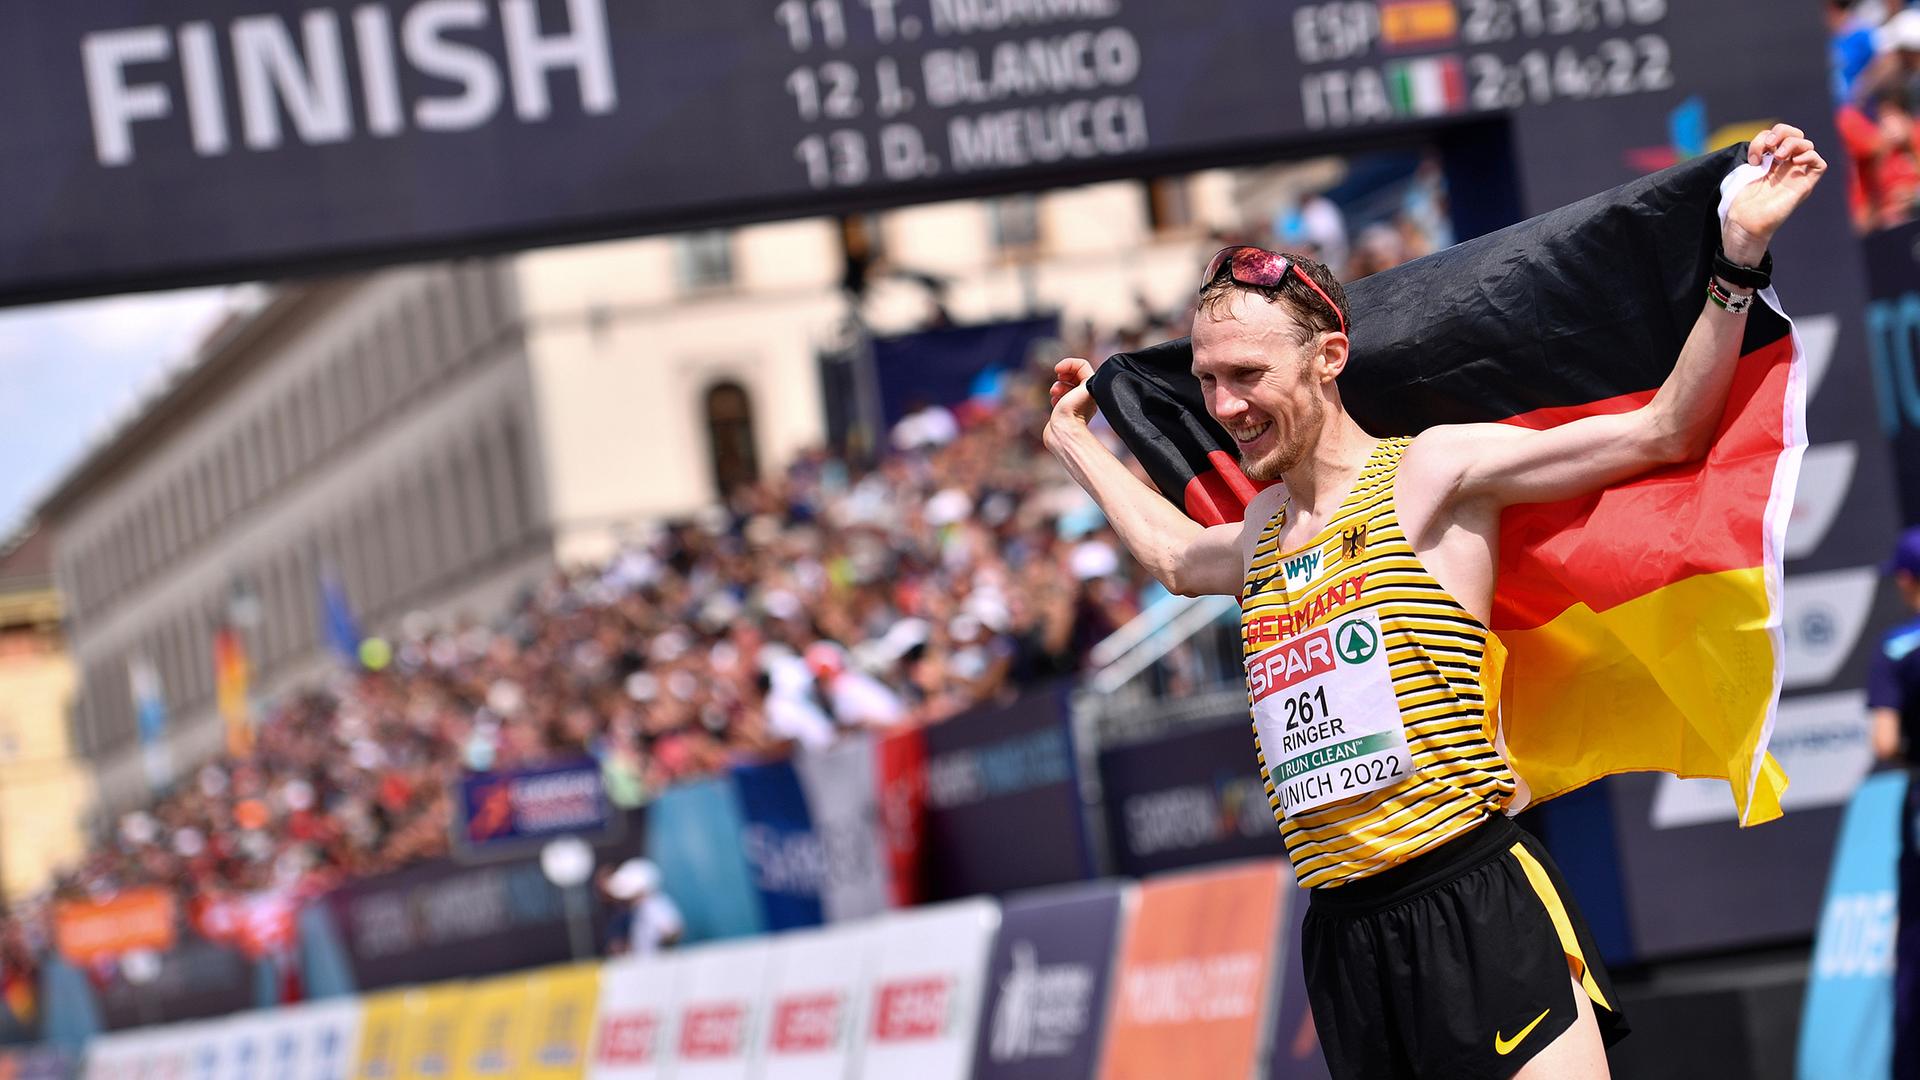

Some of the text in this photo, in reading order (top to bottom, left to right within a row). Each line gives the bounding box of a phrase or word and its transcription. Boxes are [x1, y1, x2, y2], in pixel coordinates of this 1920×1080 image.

[775, 0, 847, 52] 11
[1294, 4, 1380, 64] ESP
[82, 0, 618, 166] FINISH
[787, 62, 862, 122] 12
[922, 27, 1142, 106] BLANCO
[1301, 34, 1674, 130] ITA 2:14:22
[795, 95, 1149, 190] 13 D. MEUCCI
[1247, 571, 1369, 645] GERMANY
[1251, 635, 1332, 697] SPAR
[1282, 717, 1346, 754] RINGER
[1284, 685, 1329, 732] 261
[1285, 756, 1310, 778] RUN
[1340, 755, 1403, 790] 2022
